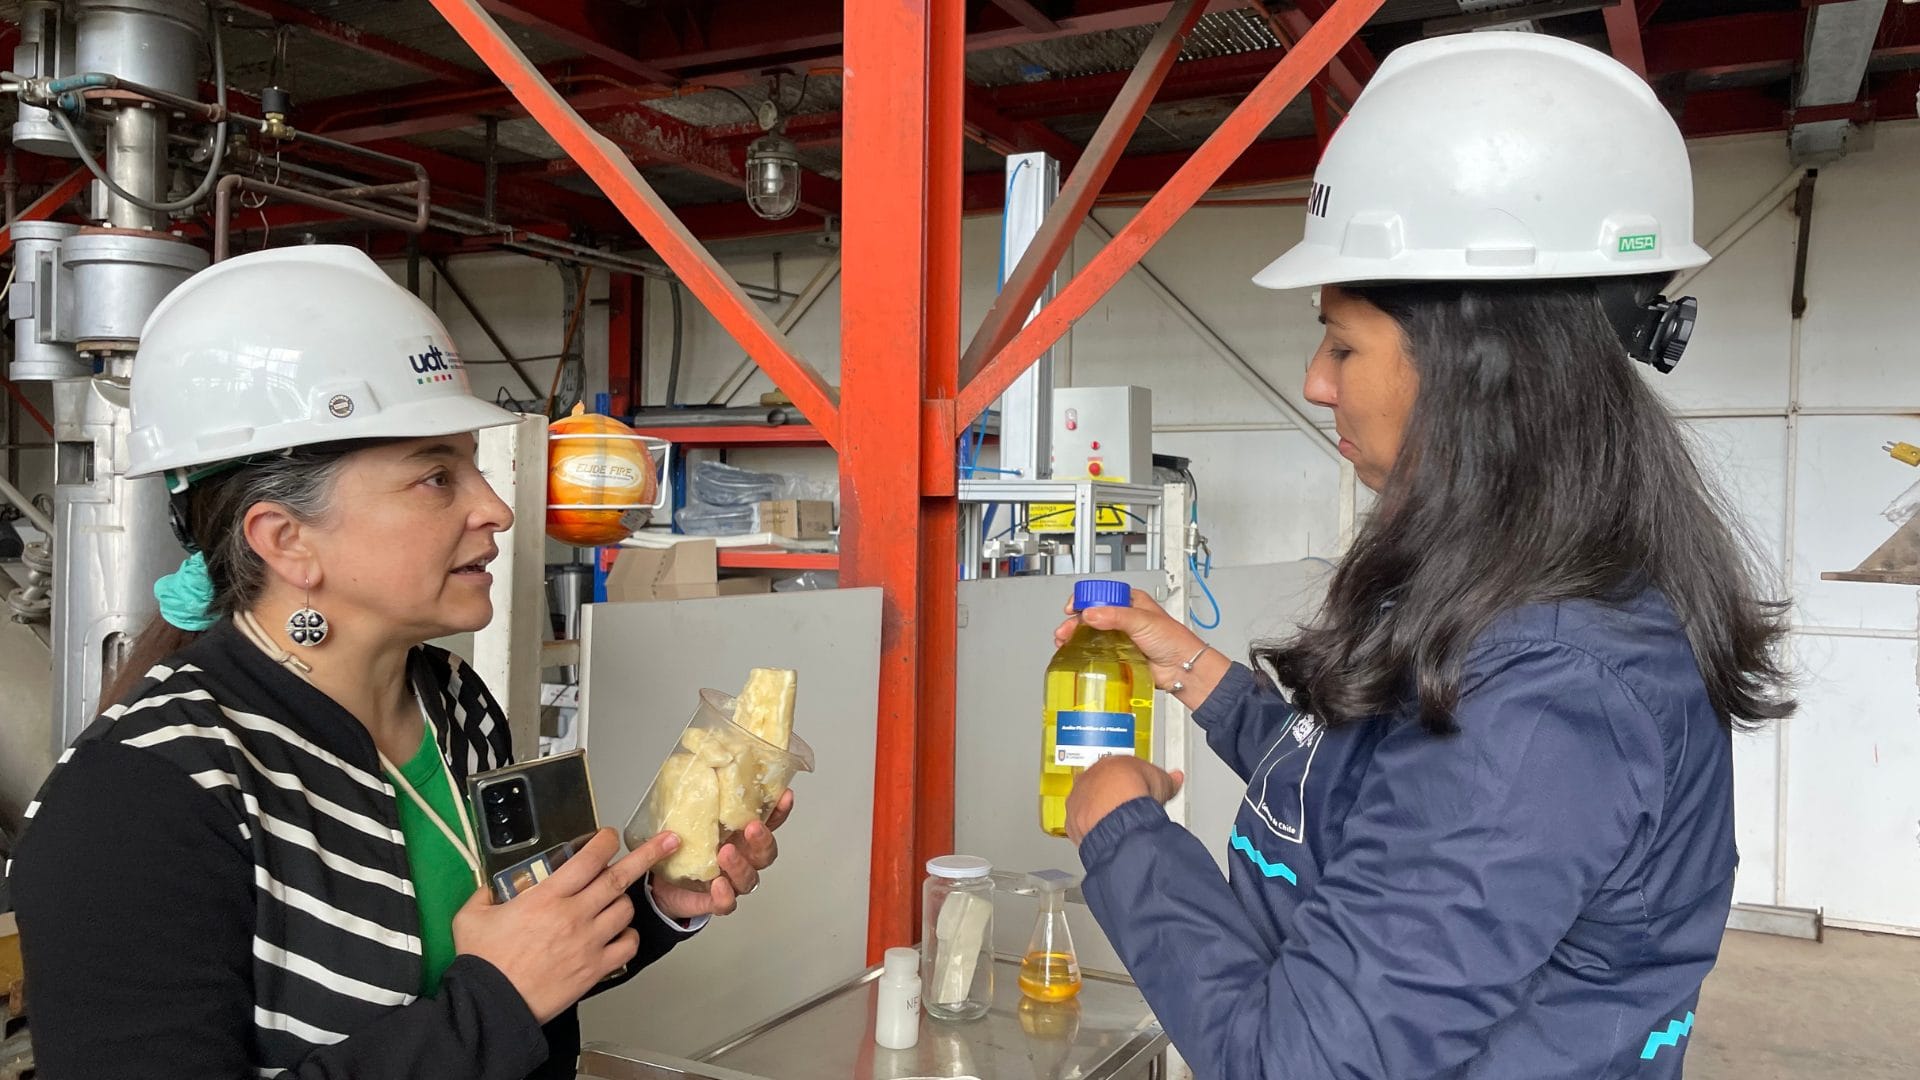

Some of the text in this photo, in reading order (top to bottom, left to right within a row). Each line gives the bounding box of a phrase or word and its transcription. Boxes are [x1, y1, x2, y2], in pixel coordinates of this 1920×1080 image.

[1309, 182, 1331, 218] MI
[1620, 236, 1654, 250] MSA
[408, 344, 448, 373] udt
[609, 465, 633, 477] FIRE
[1278, 822, 1296, 835] Chile
